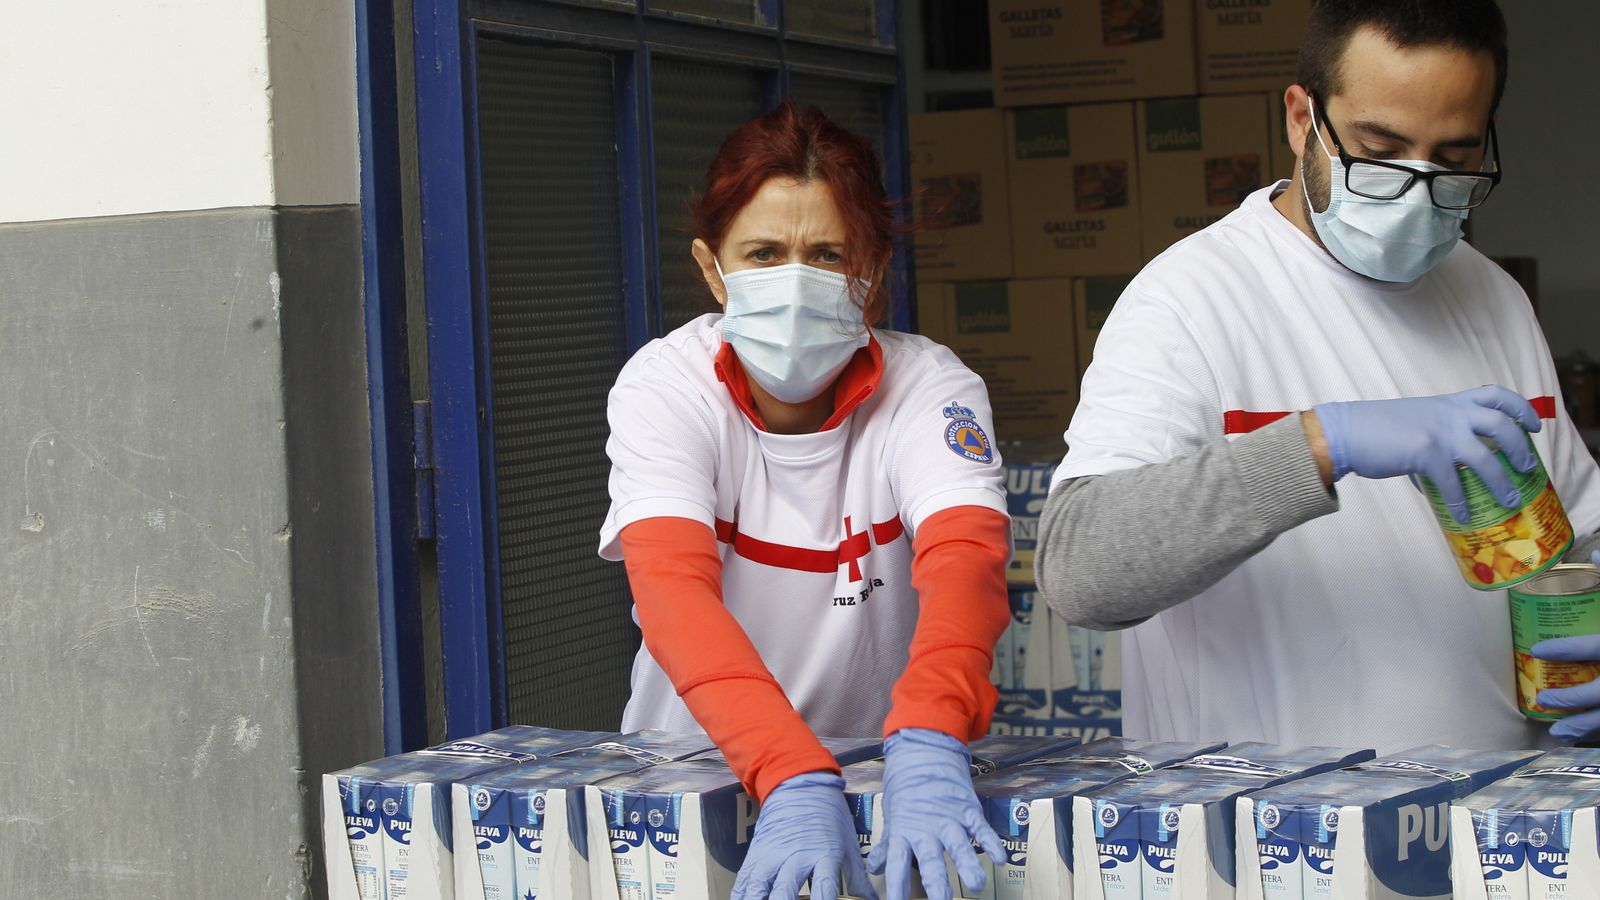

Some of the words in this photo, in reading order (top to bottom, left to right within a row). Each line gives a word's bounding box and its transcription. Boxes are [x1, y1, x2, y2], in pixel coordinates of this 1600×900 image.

[1000, 7, 1062, 23] GALLETAS
[1043, 219, 1105, 233] GALLETAS
[833, 596, 856, 606] ruz
[345, 816, 374, 828] ULEVA
[390, 819, 412, 831] PUL
[473, 826, 500, 837] LEVA
[519, 827, 544, 839] PULE
[609, 829, 637, 841] ULEVA
[656, 831, 679, 843] PUL
[350, 843, 368, 853] TERA
[1002, 838, 1027, 851] PULE
[1097, 843, 1128, 855] LEVA
[1148, 844, 1176, 858] PULE
[1258, 844, 1289, 857] LEVA
[479, 853, 495, 862] TERA
[527, 857, 541, 865] ENT
[613, 858, 632, 867] TERA
[1480, 853, 1514, 864] LEVA
[1008, 870, 1025, 879] ENT
[1103, 873, 1121, 882] TERA
[1263, 874, 1282, 883] TERA
[1156, 876, 1173, 885] ENT
[1316, 878, 1332, 886] ENT
[1487, 884, 1507, 892] TERA
[1548, 884, 1566, 892] ENT
